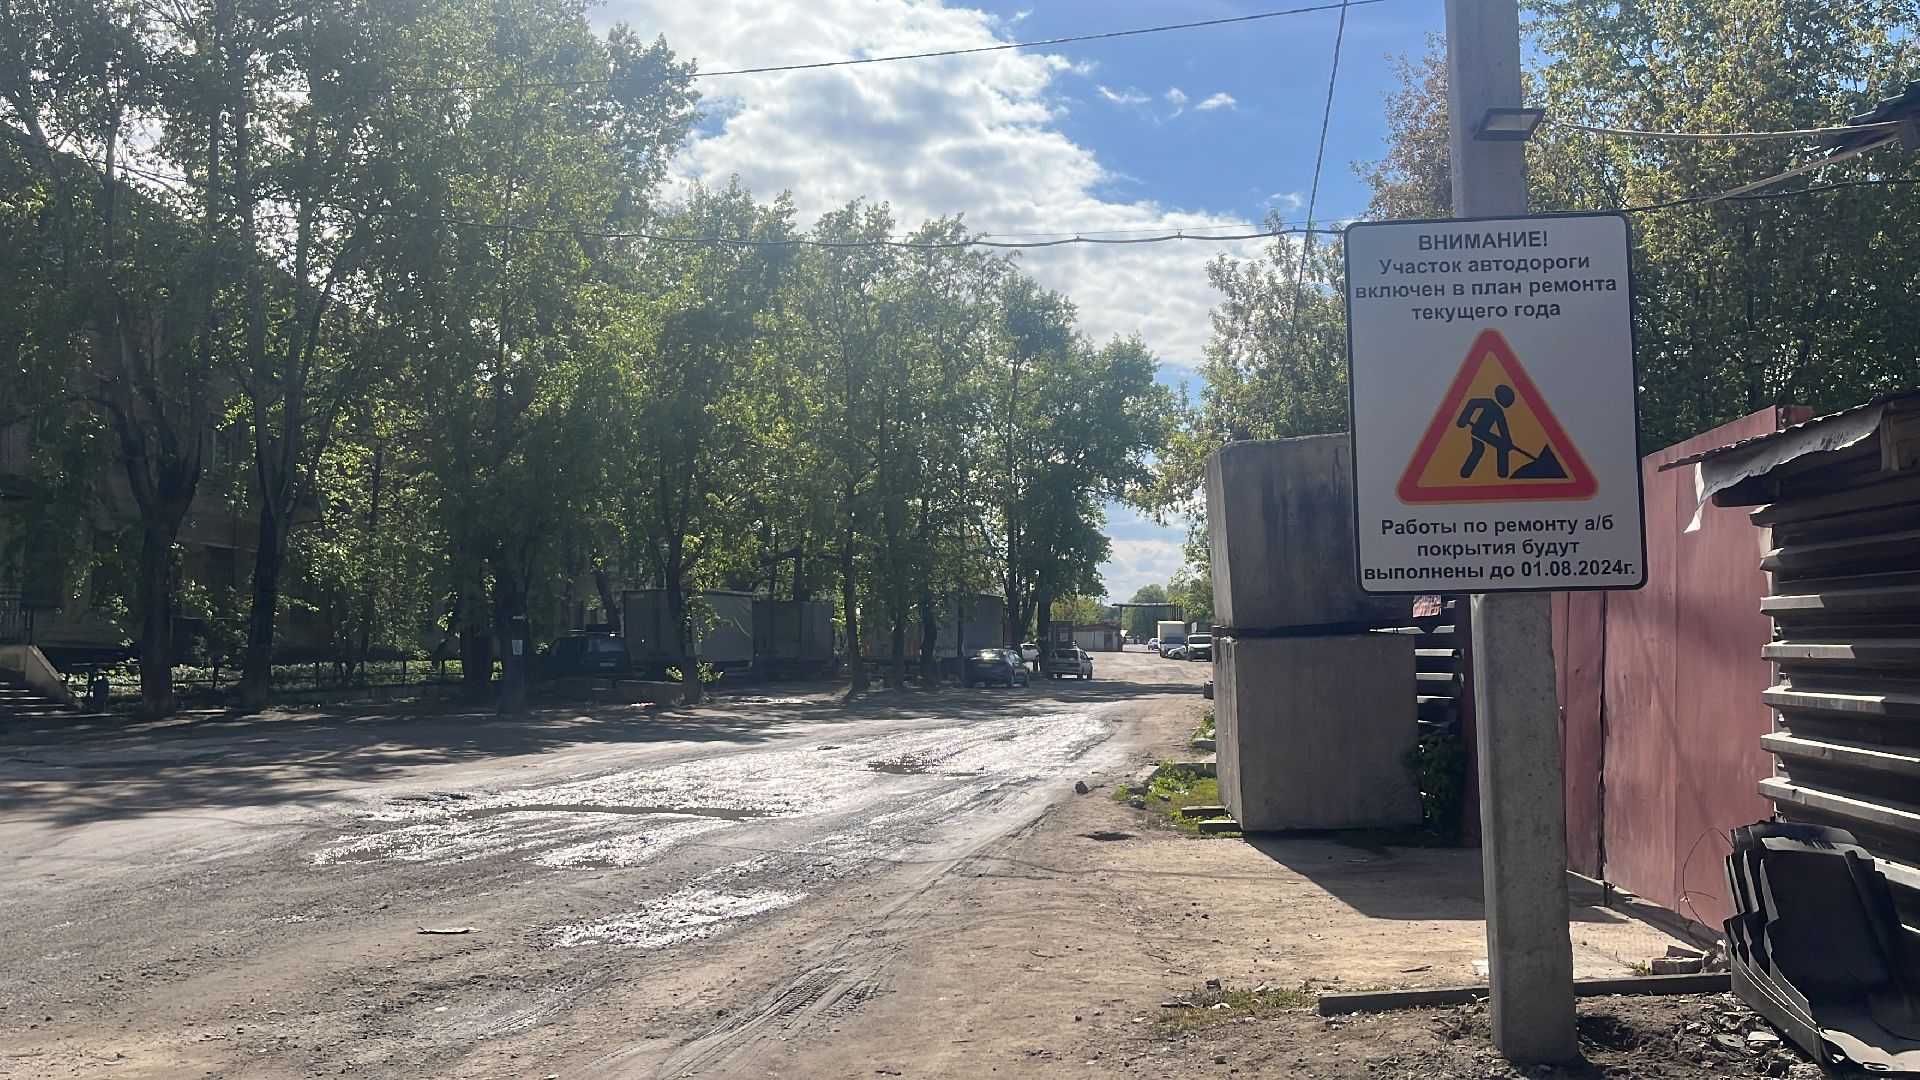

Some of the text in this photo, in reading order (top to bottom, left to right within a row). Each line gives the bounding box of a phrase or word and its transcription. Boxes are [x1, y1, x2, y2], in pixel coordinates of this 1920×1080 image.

[1419, 231, 1548, 250] ВНИМАНИЕ!
[1380, 256, 1590, 274] Участок автодороги
[1356, 277, 1616, 298] включен в план ремонта
[1411, 303, 1561, 323] текущего года
[1382, 514, 1614, 537] Работы по ремонту а/б
[1418, 539, 1580, 558] покрытия будут
[1364, 560, 1636, 580] выполнены до 01.08.2024г.
